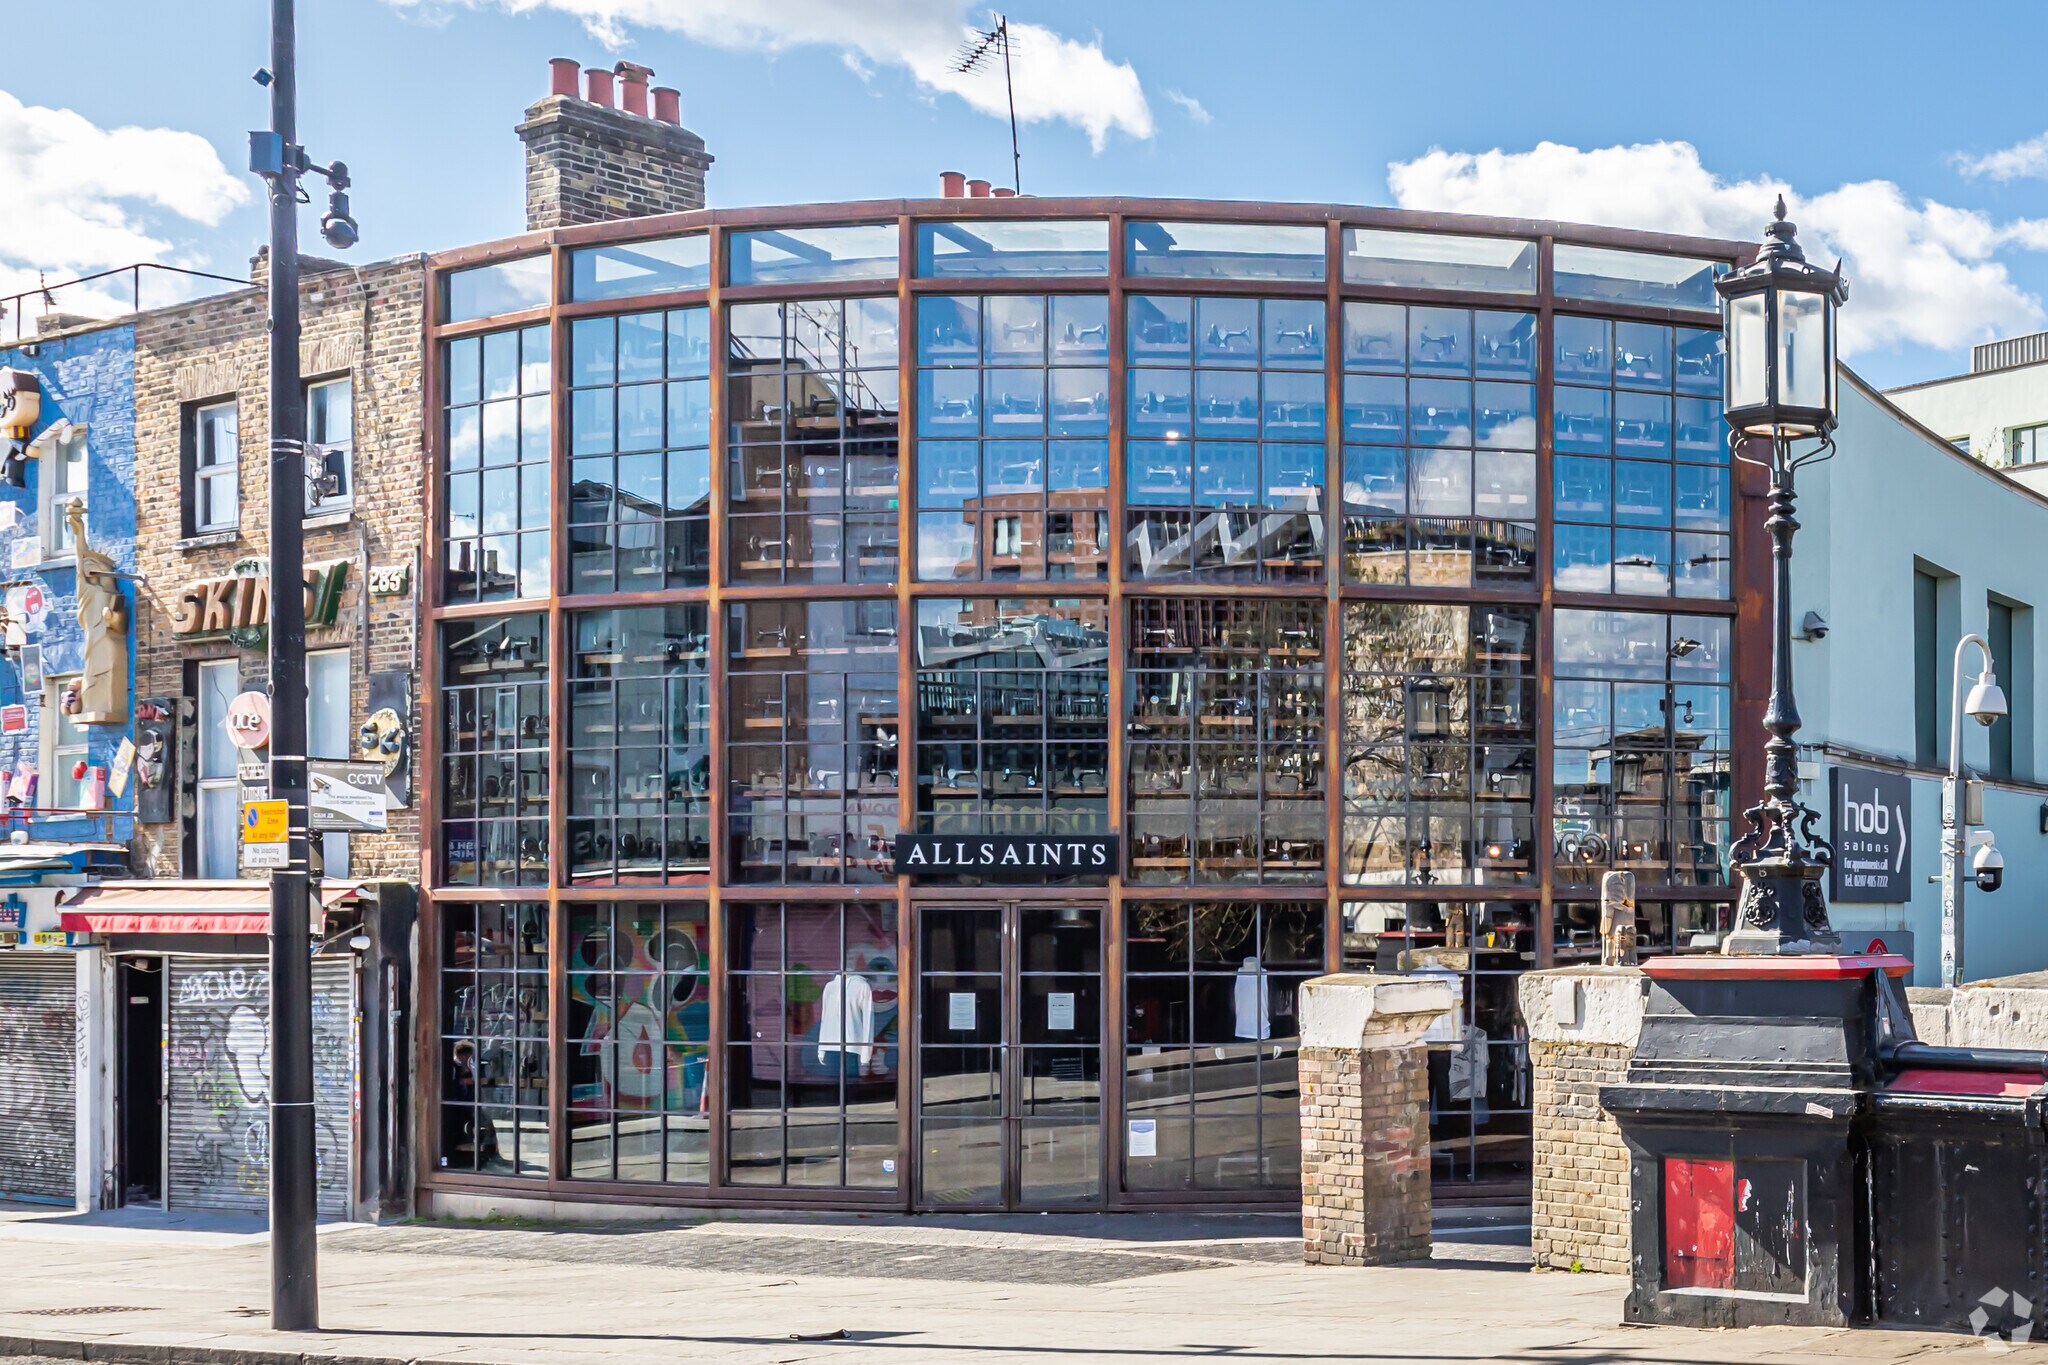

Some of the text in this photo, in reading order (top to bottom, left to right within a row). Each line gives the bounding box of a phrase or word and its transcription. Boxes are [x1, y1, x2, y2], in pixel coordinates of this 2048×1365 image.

[369, 570, 400, 592] 285
[347, 773, 383, 785] CCTV
[1844, 783, 1889, 835] hob
[906, 843, 1106, 866] ALLSAINTS
[1844, 841, 1889, 853] salons
[1844, 857, 1889, 873] For appointments call
